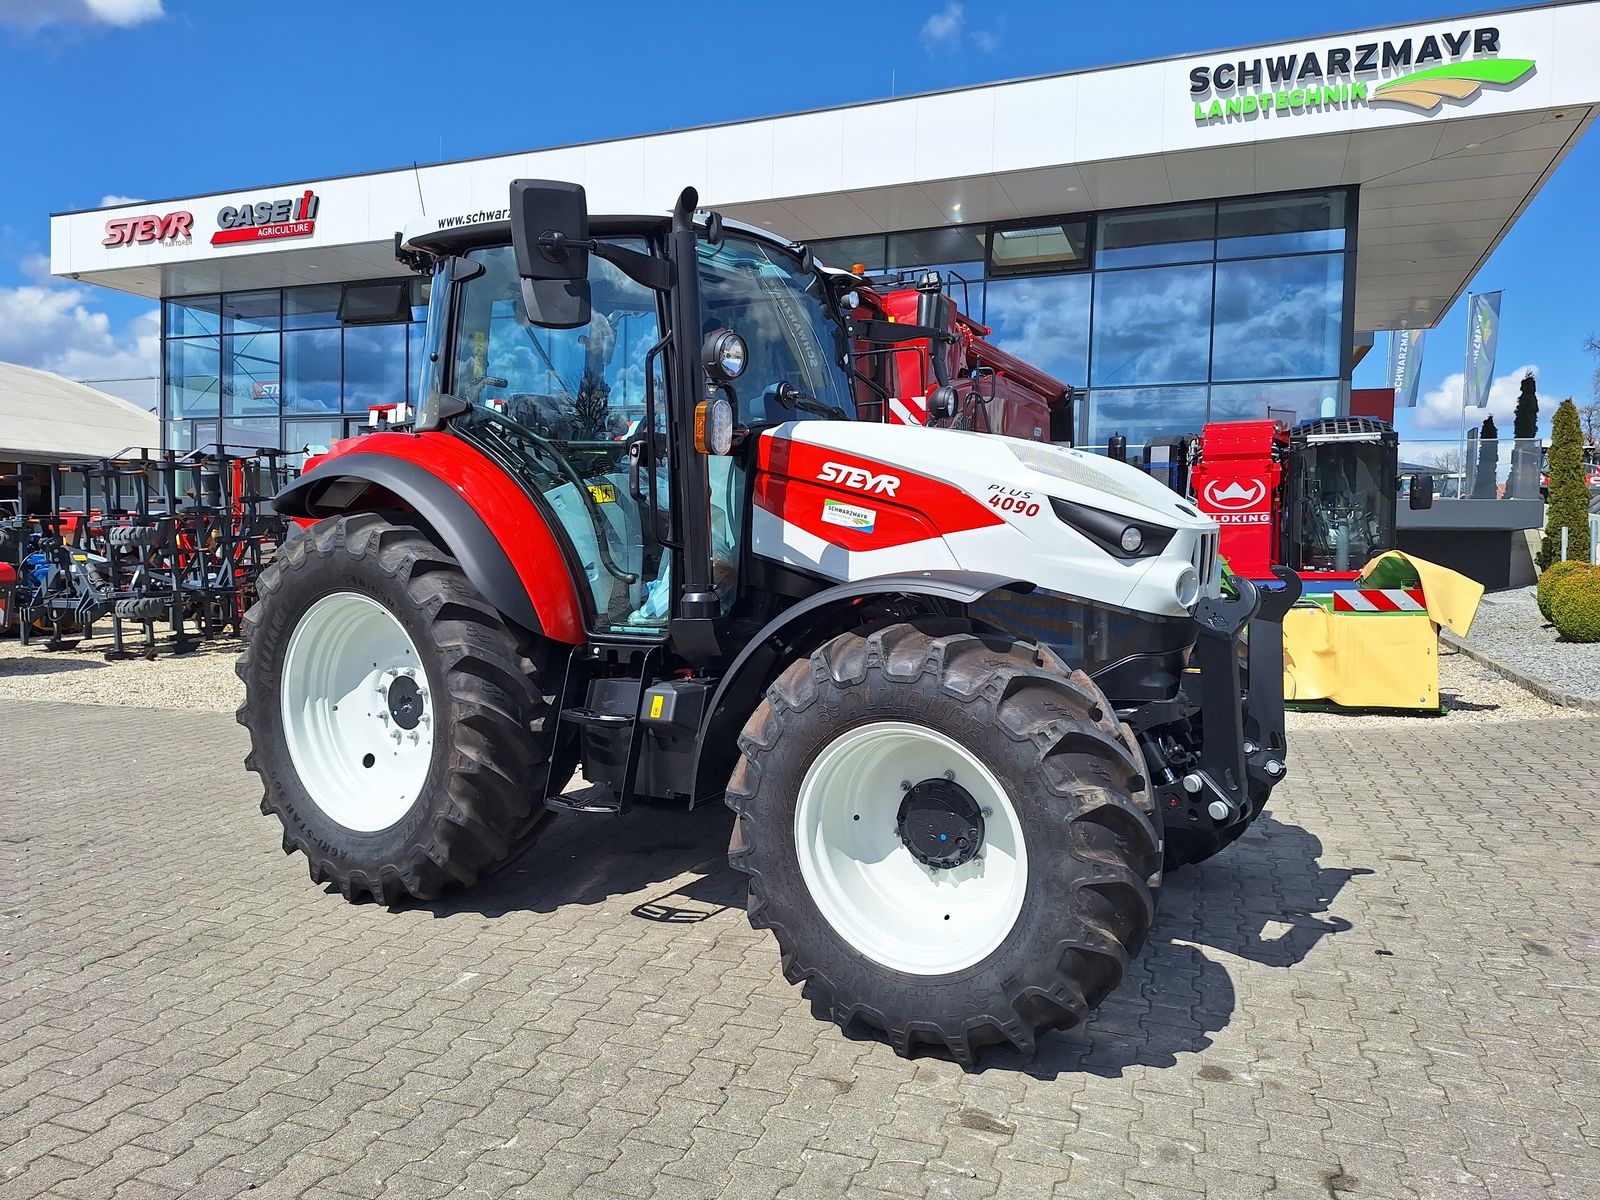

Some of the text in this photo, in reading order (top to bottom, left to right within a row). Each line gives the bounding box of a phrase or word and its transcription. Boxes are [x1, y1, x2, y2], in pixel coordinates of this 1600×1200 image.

[1190, 27, 1500, 93] SCHWARZMAYR
[1195, 81, 1368, 121] LANDTECHNIK
[217, 198, 292, 230] CASE
[102, 211, 193, 247] STEYR
[257, 223, 309, 237] AGRICULTURE
[162, 240, 193, 248] TRAKTOREN
[816, 461, 901, 498] STEYR
[988, 484, 1034, 499] PLUS
[828, 505, 868, 519] SCHWARZMAYR
[988, 494, 1041, 517] 4090
